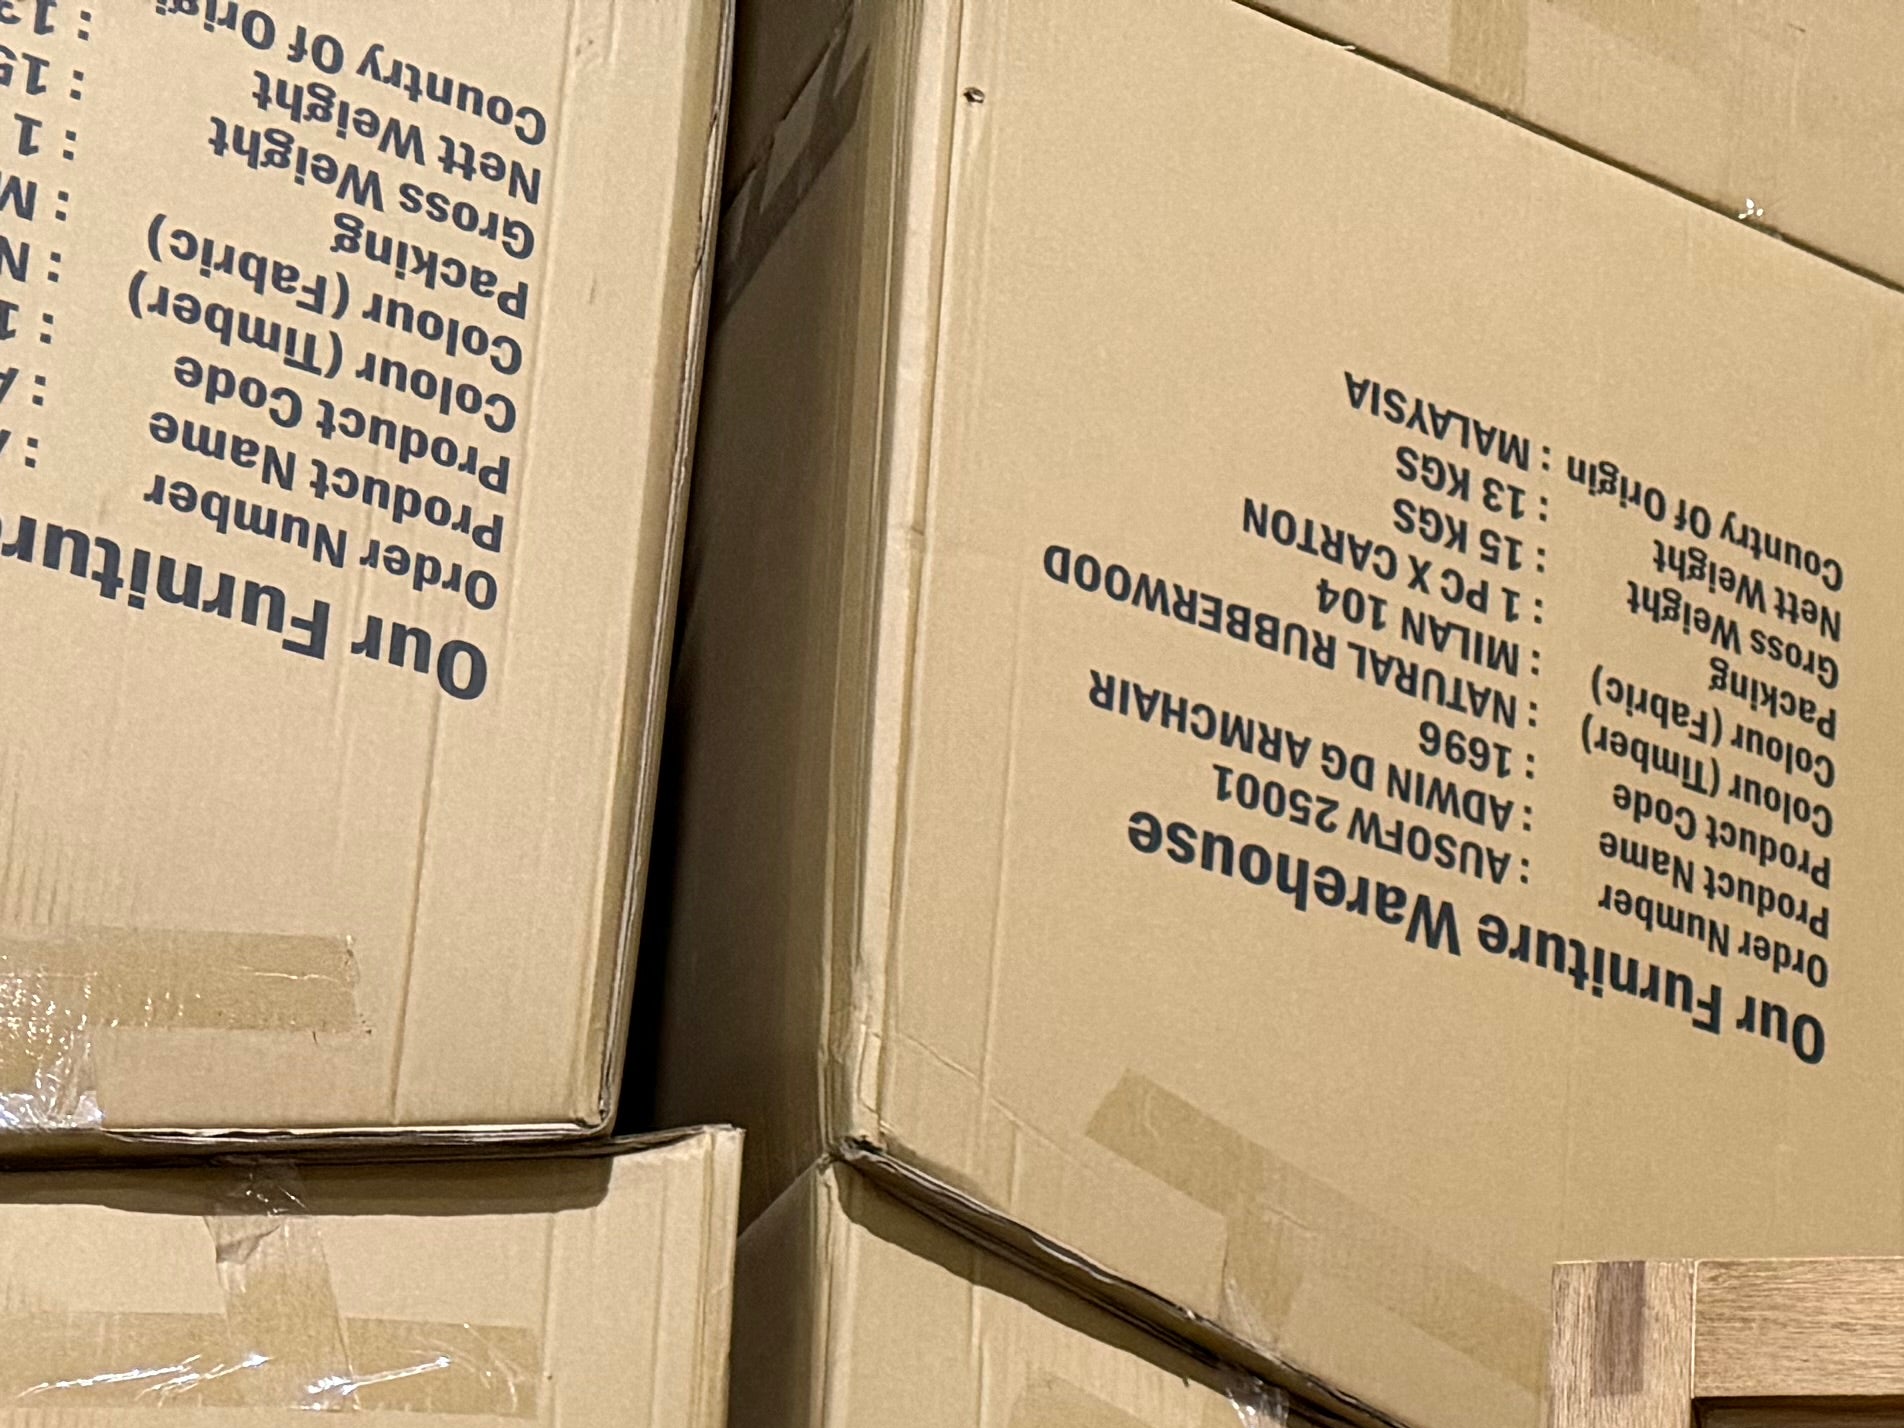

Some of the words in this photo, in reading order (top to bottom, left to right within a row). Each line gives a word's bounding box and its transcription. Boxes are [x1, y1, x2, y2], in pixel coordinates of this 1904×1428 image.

[286, 23, 345, 74] Of
[251, 68, 425, 165] Weight
[357, 41, 546, 145] Country
[207, 114, 383, 212] Weight
[436, 133, 540, 204] Nett
[397, 181, 533, 259] Gross
[146, 211, 349, 319] (Fabric)
[329, 211, 527, 320] Packing
[127, 268, 342, 379] (Timber)
[359, 291, 521, 375] Colour
[172, 354, 303, 427] Code
[353, 350, 515, 434] Colour
[147, 410, 296, 490] Name
[314, 397, 509, 495] Product
[141, 472, 347, 568] Number
[308, 456, 503, 554] Product
[0, 513, 330, 660] Furnitur
[357, 536, 498, 611] Order
[1041, 543, 1336, 670] RUBBERWOOD
[349, 613, 489, 701] Our
[1345, 639, 1516, 729] NATURAL
[1087, 667, 1312, 768] ARMCHAIR
[1579, 711, 1720, 798] (Timber)
[1211, 762, 1339, 833] 25001
[1320, 740, 1374, 791] DG
[1386, 761, 1514, 832] ADWIN
[1727, 772, 1833, 838] Colour
[1126, 809, 1461, 956] Warehouse
[1345, 805, 1511, 884] AUSOFW
[1597, 830, 1694, 893] Name
[1596, 882, 1729, 957] Number
[1701, 864, 1829, 940] Product
[1476, 912, 1721, 1035] Furniture
[1736, 929, 1828, 988] Order
[1734, 993, 1825, 1065] Our
